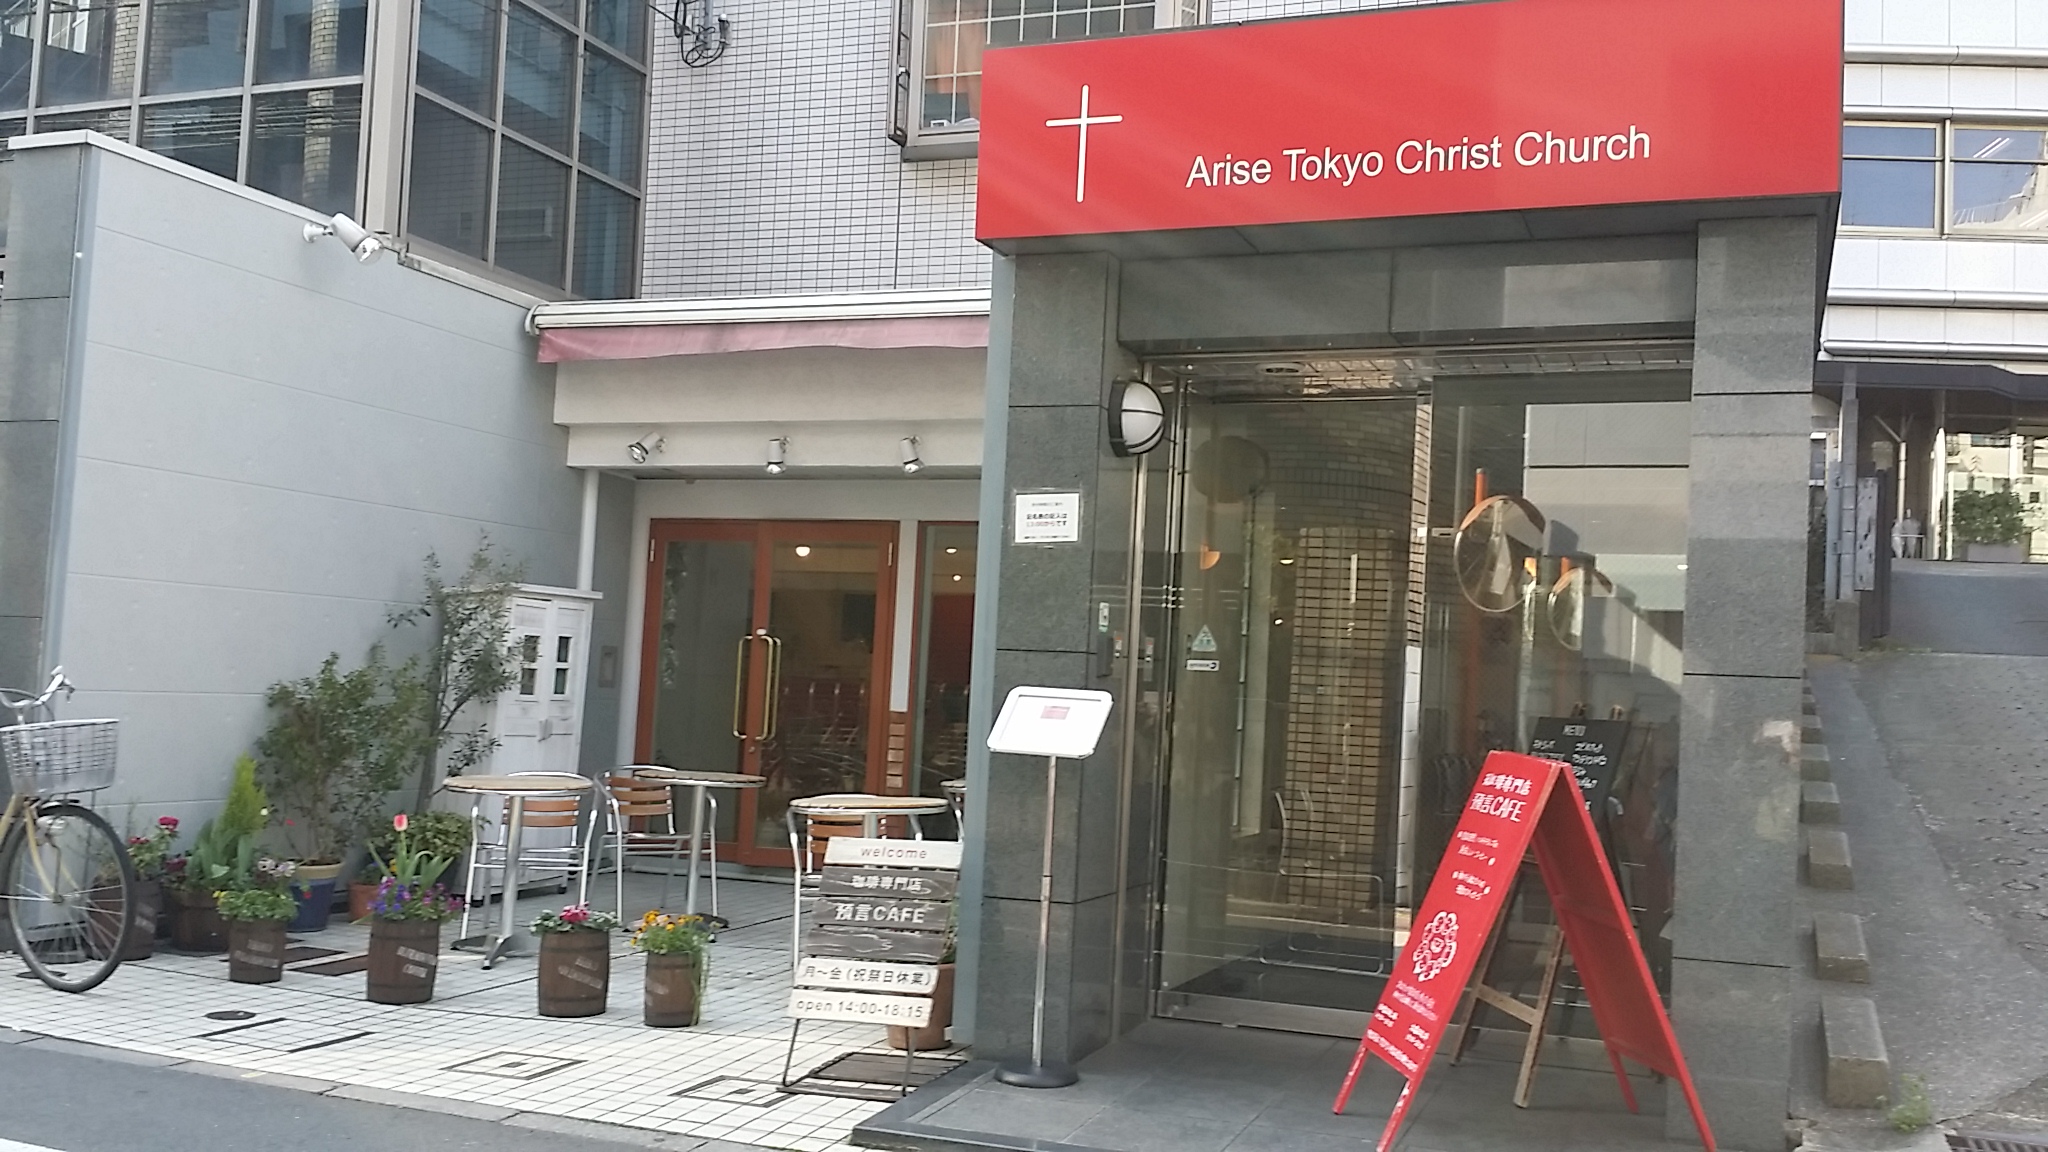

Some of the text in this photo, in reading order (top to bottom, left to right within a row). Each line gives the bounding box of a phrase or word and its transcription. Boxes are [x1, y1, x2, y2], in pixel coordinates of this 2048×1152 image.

[1185, 124, 1653, 189] Arise Tokyo Christ Church
[861, 846, 928, 859] welcome
[851, 875, 923, 891] 珈琲専門店
[834, 902, 927, 924] 預言CAFE
[796, 999, 833, 1012] open
